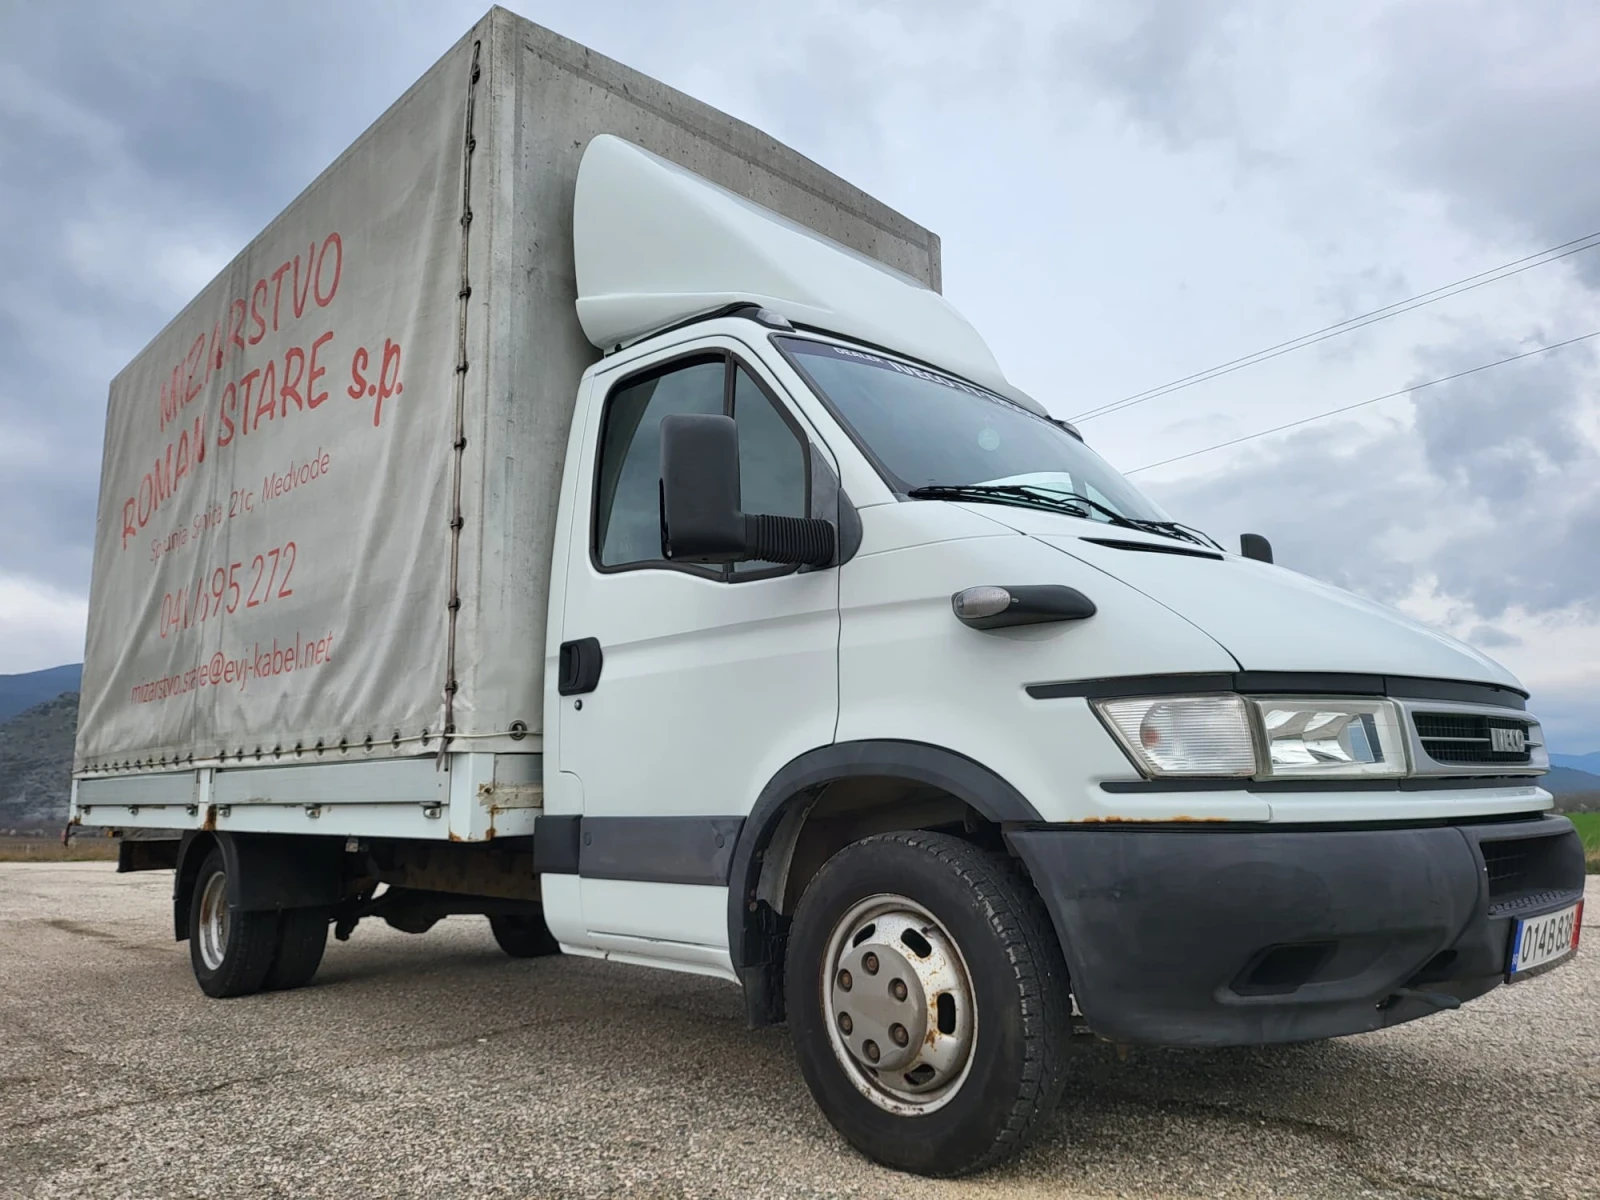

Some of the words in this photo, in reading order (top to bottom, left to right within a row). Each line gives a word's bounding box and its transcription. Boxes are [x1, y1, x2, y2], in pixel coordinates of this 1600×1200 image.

[159, 231, 343, 433] MIZARSTVO
[888, 360, 956, 388] IVECO
[121, 412, 206, 551] ROMAN
[217, 330, 334, 448] STARE
[347, 337, 403, 428] s.p.
[229, 488, 254, 518] 21c,
[261, 447, 330, 503] Medvode
[246, 541, 297, 608] 272
[1490, 727, 1526, 753] IVECO
